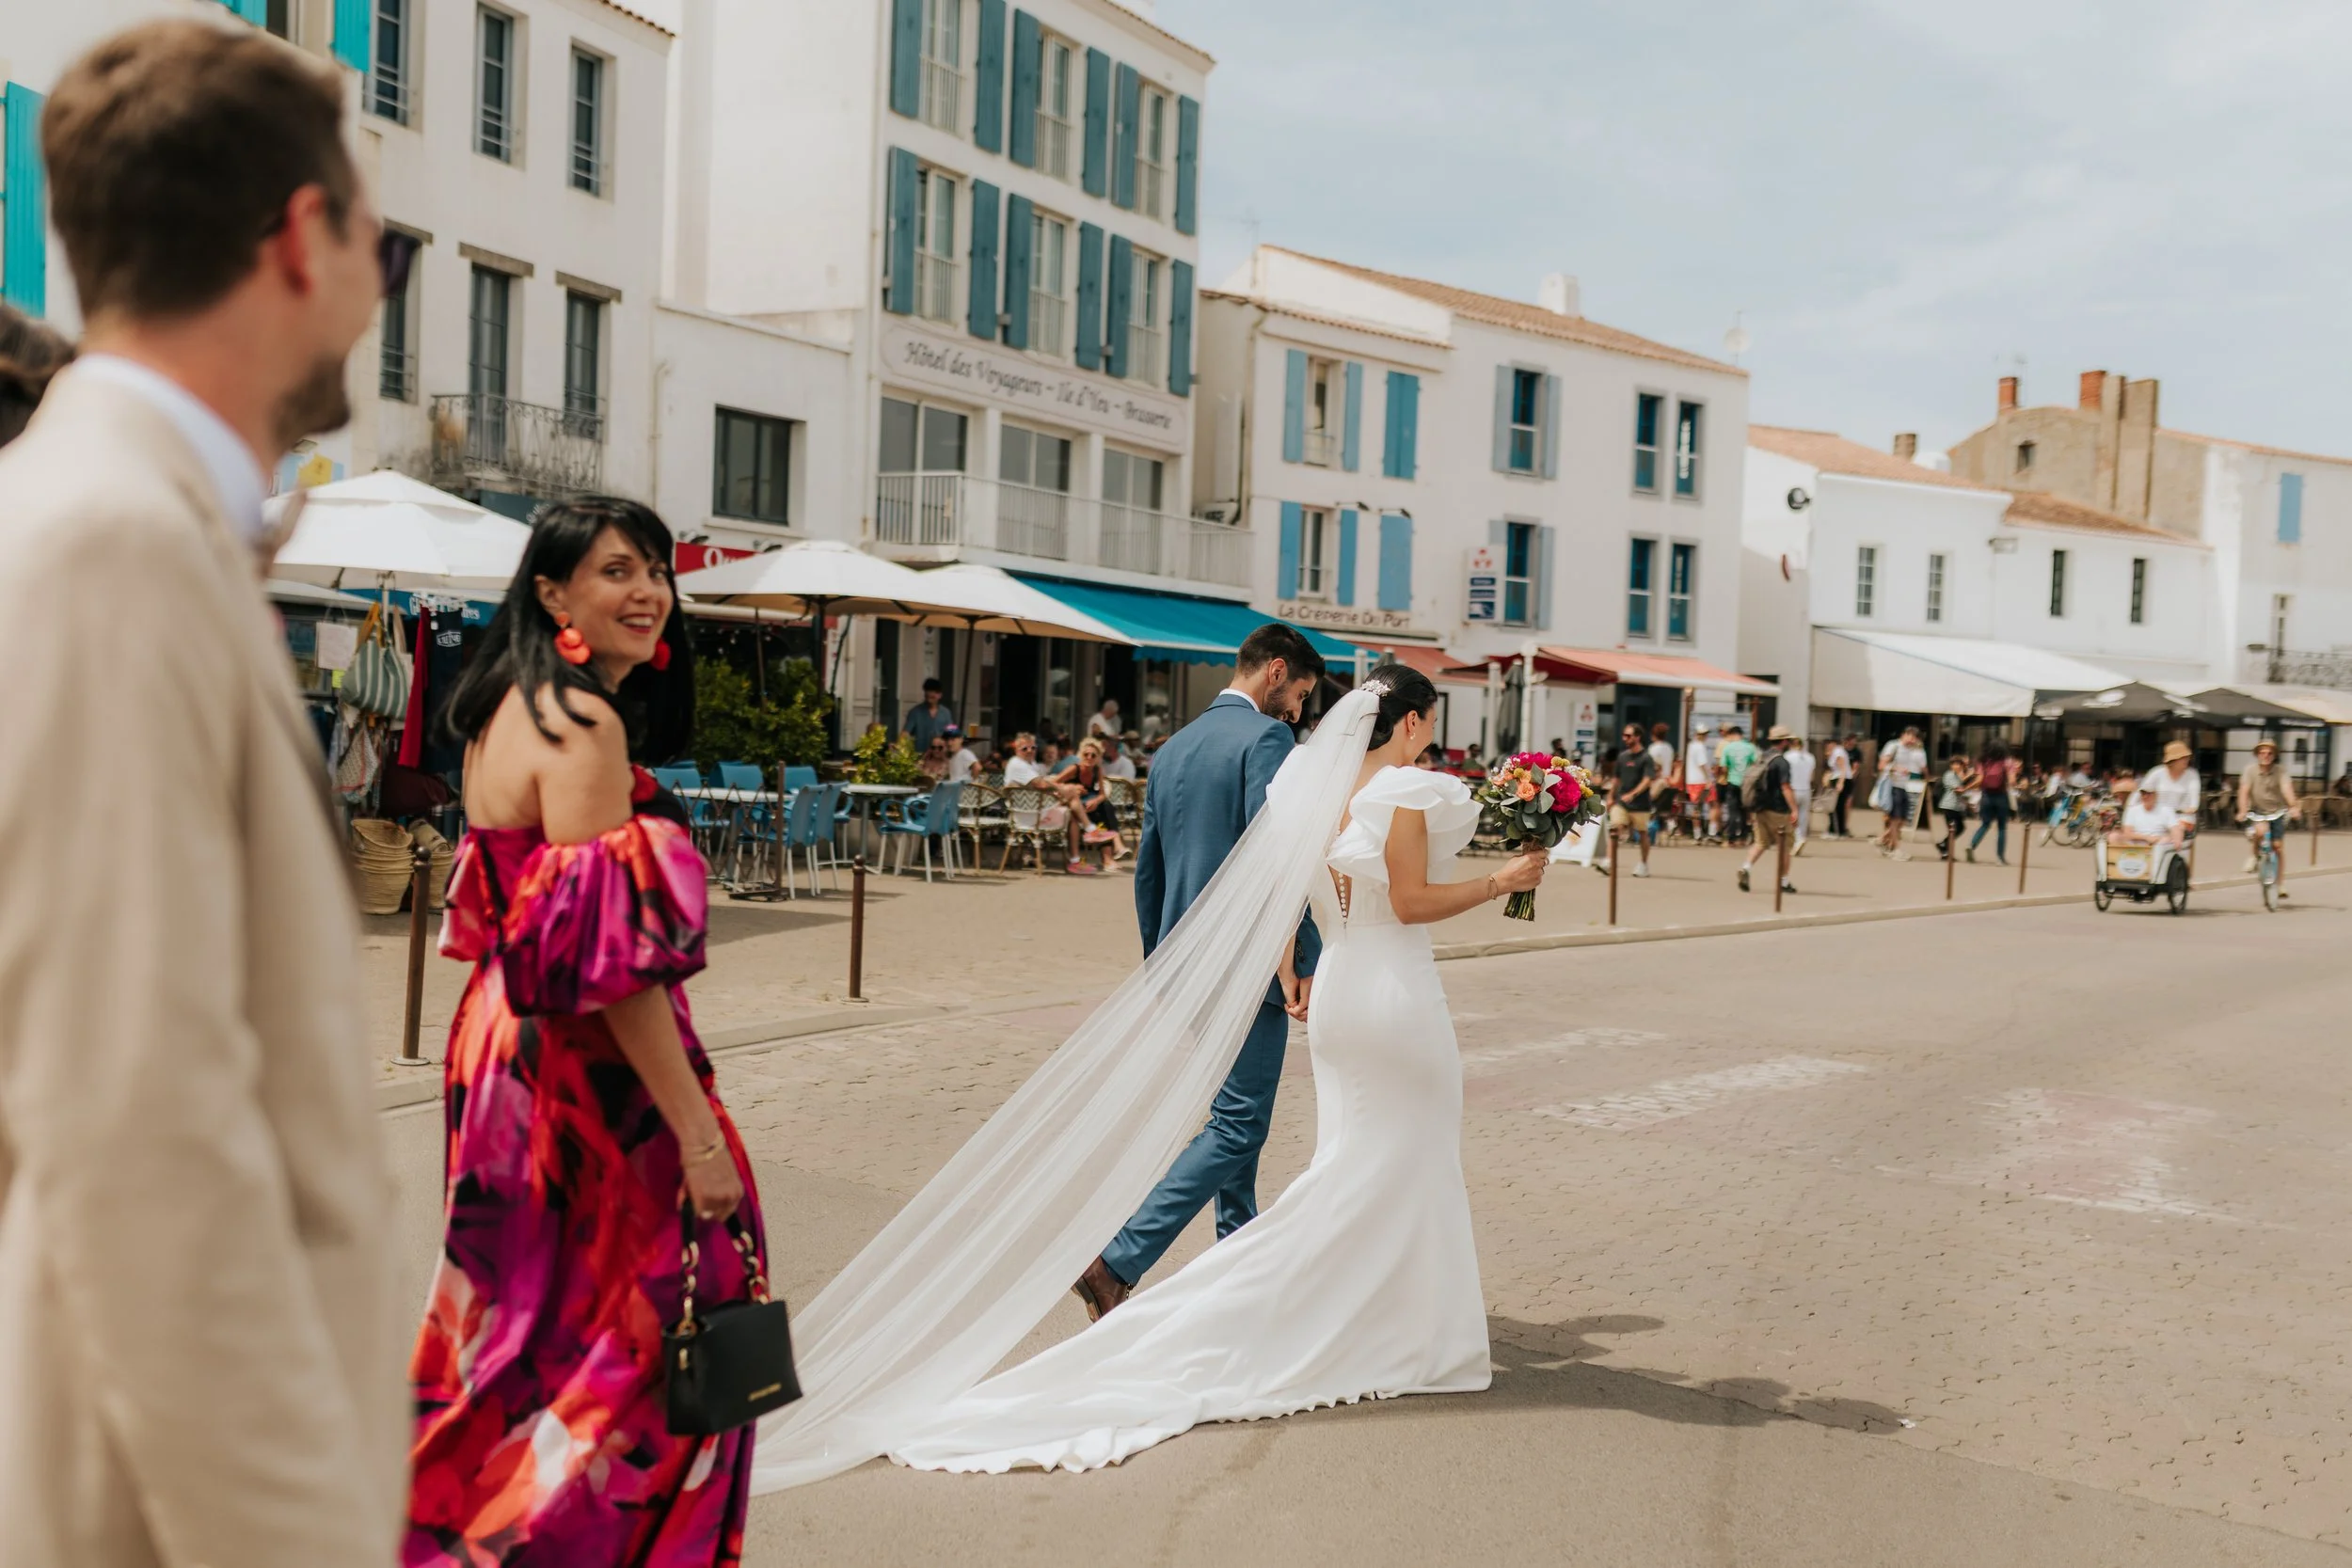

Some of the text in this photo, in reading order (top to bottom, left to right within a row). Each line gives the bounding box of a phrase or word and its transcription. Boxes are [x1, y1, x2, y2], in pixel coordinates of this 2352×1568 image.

[903, 341, 949, 372] Hôtel
[949, 352, 972, 378] des
[976, 359, 1042, 397] Voyageurs
[1124, 401, 1172, 429] Brasserie
[1278, 604, 1295, 618] La
[1383, 612, 1410, 628] Port
